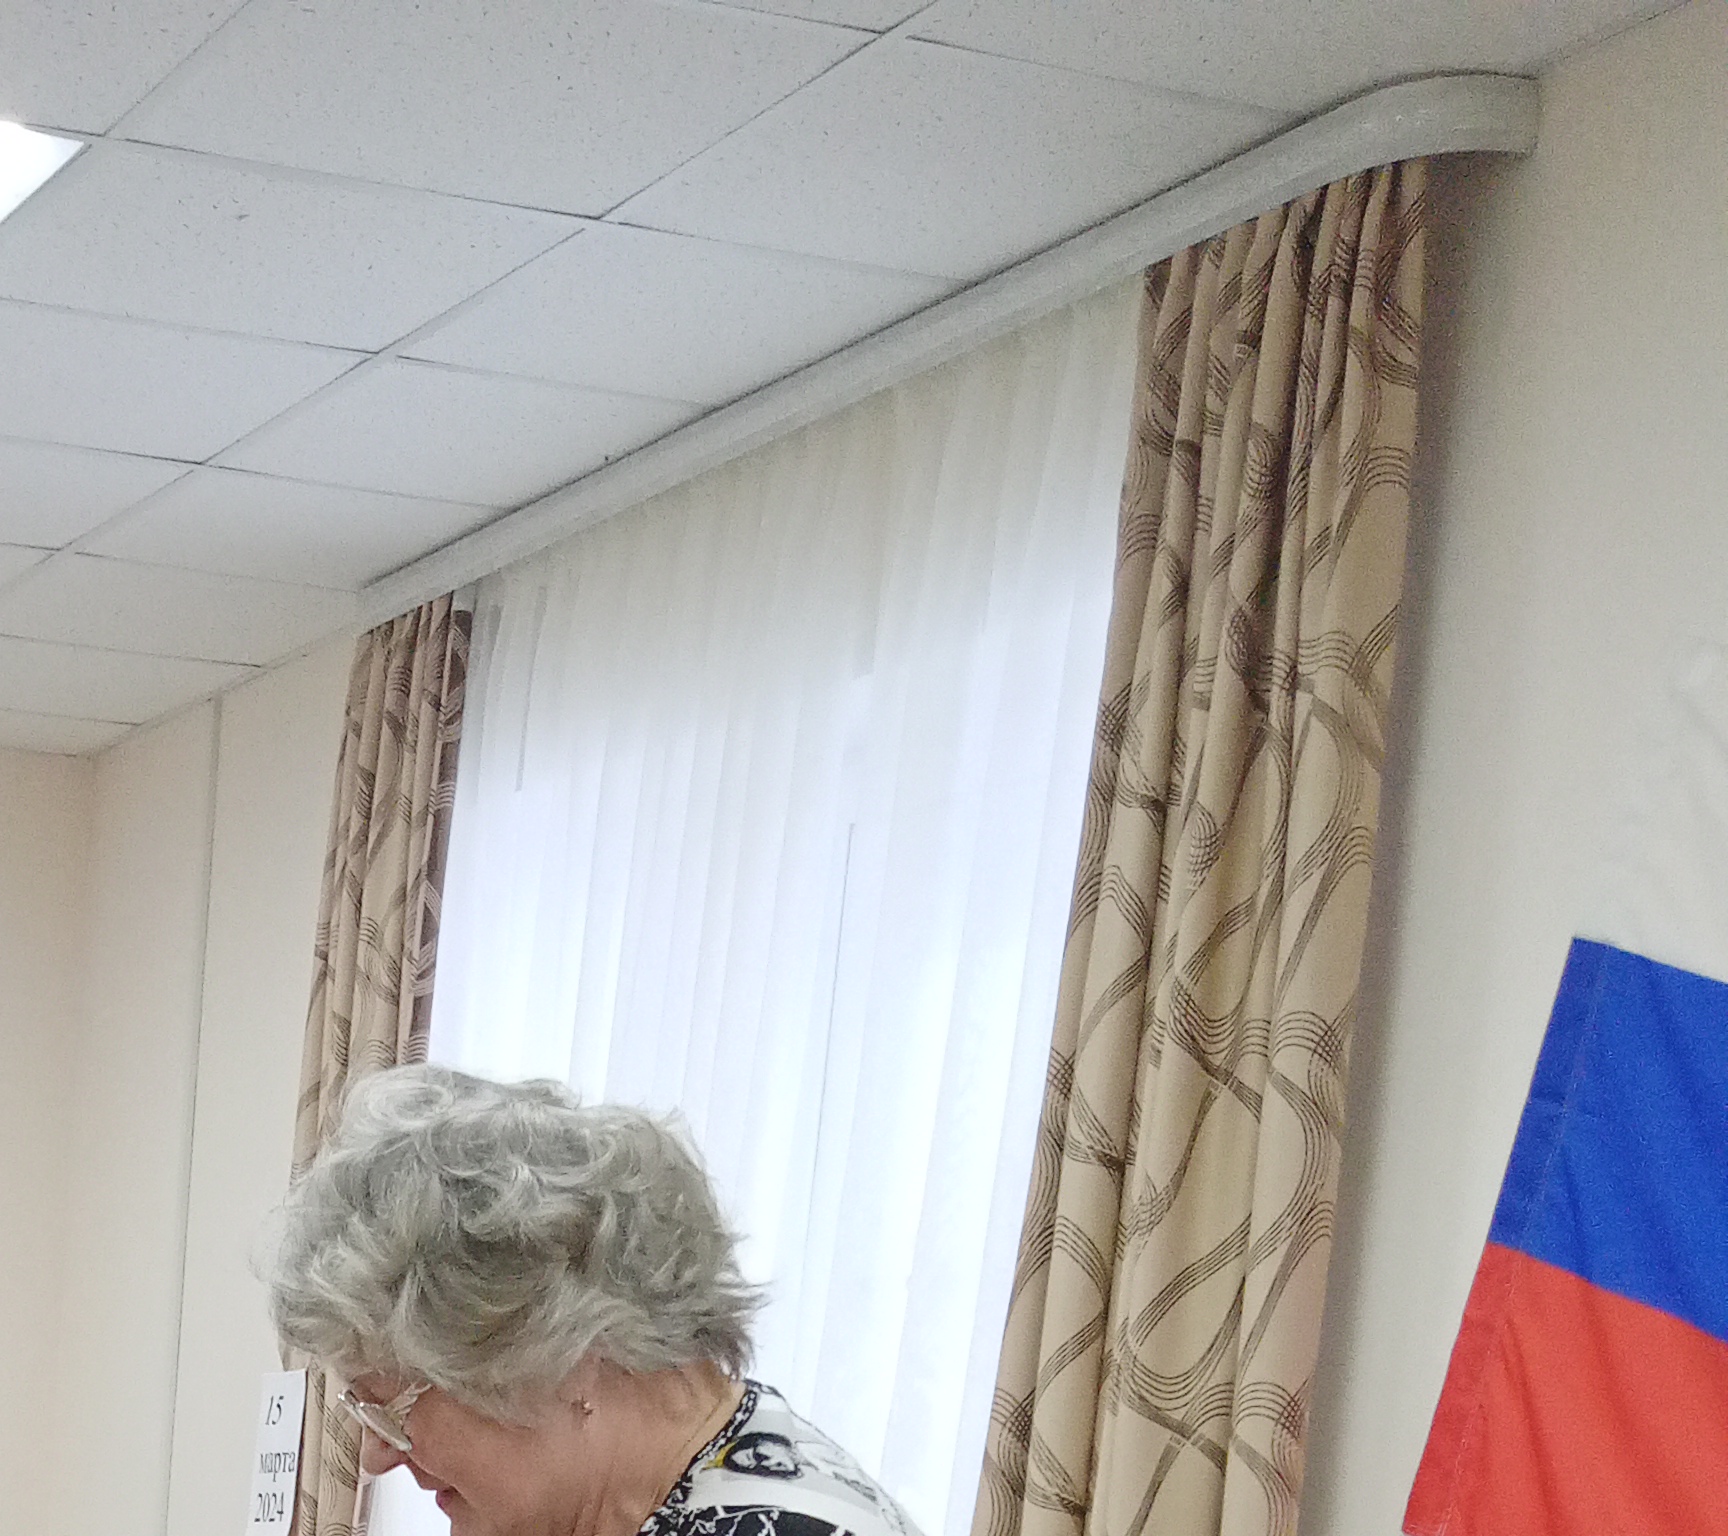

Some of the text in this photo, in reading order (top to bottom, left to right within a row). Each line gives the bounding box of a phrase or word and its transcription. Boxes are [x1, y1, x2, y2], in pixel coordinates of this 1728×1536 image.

[264, 1395, 284, 1425] 15
[259, 1450, 296, 1482] марта
[254, 1492, 285, 1523] 2024
